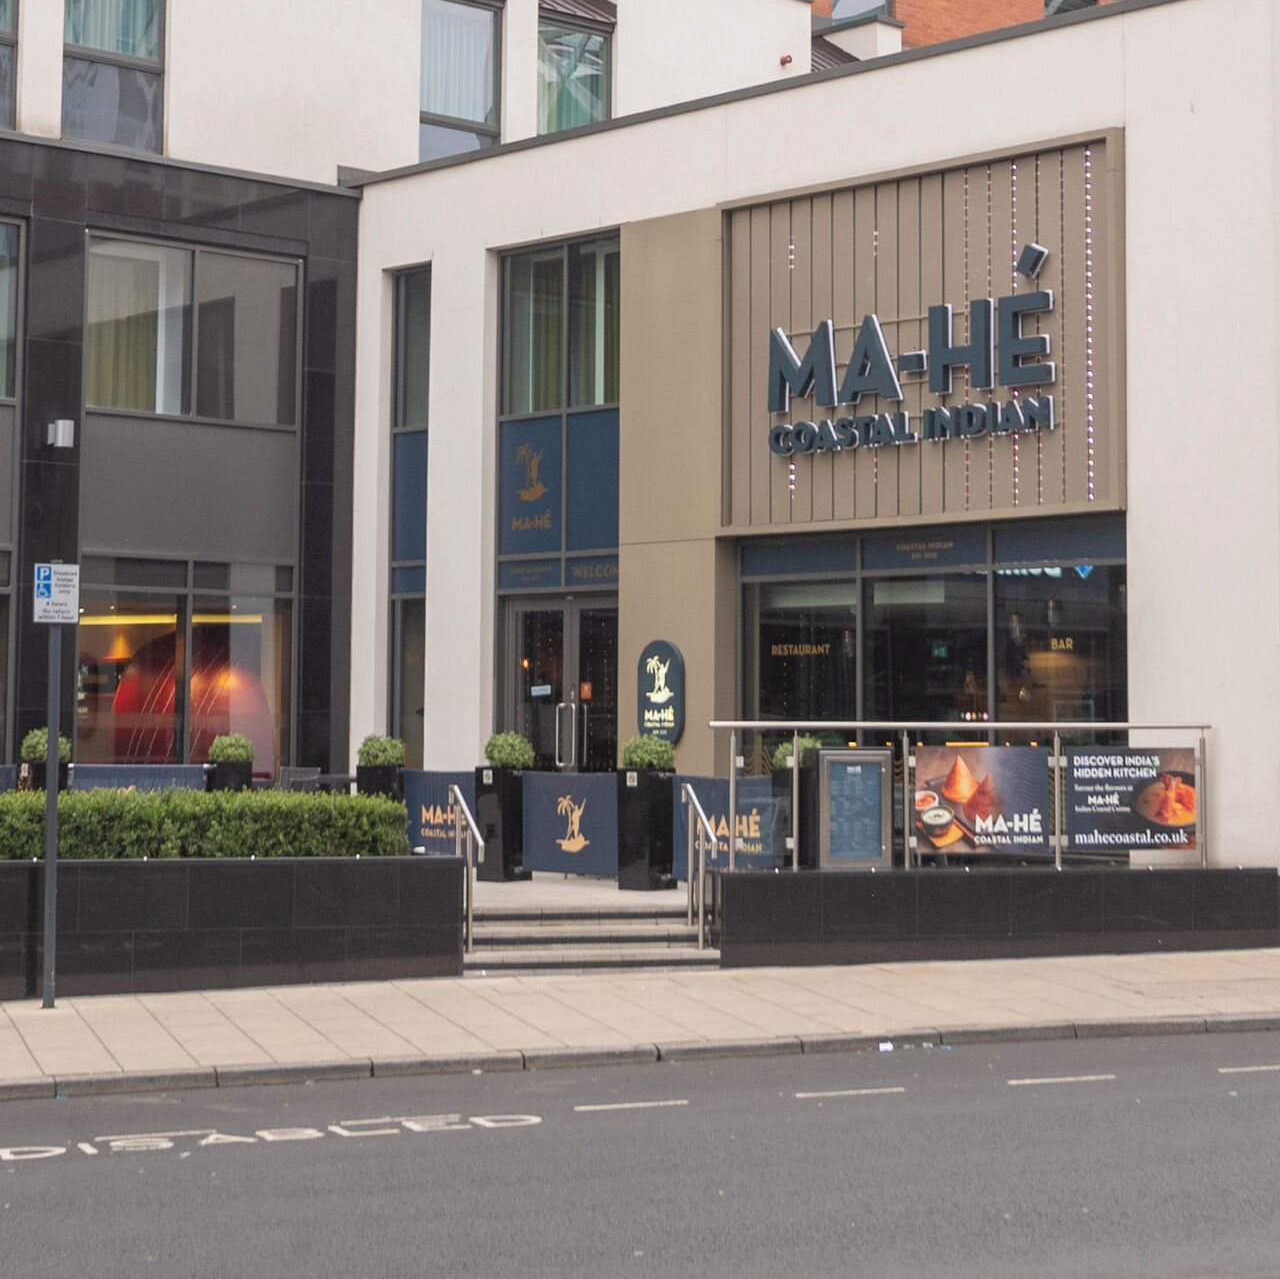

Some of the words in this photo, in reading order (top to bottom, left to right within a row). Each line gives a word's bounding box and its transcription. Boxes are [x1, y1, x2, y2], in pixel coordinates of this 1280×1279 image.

[768, 242, 1056, 413] MA-HÉ
[768, 411, 919, 457] COASTAL
[922, 394, 1055, 440] INDIAN
[40, 567, 50, 580] P
[771, 643, 831, 656] RESTAURANT
[1050, 637, 1074, 651] BAR
[1073, 755, 1124, 767] DISCOVER
[1124, 755, 1160, 768] INDIA'S
[1073, 767, 1112, 779] HIDDEN
[1113, 767, 1157, 779] KITCHEN
[975, 808, 1043, 834] MA-HÉ
[974, 834, 1012, 844] COASTAL
[1013, 834, 1044, 844] INDIAN
[1075, 828, 1189, 845] mahecoastal.co.uk
